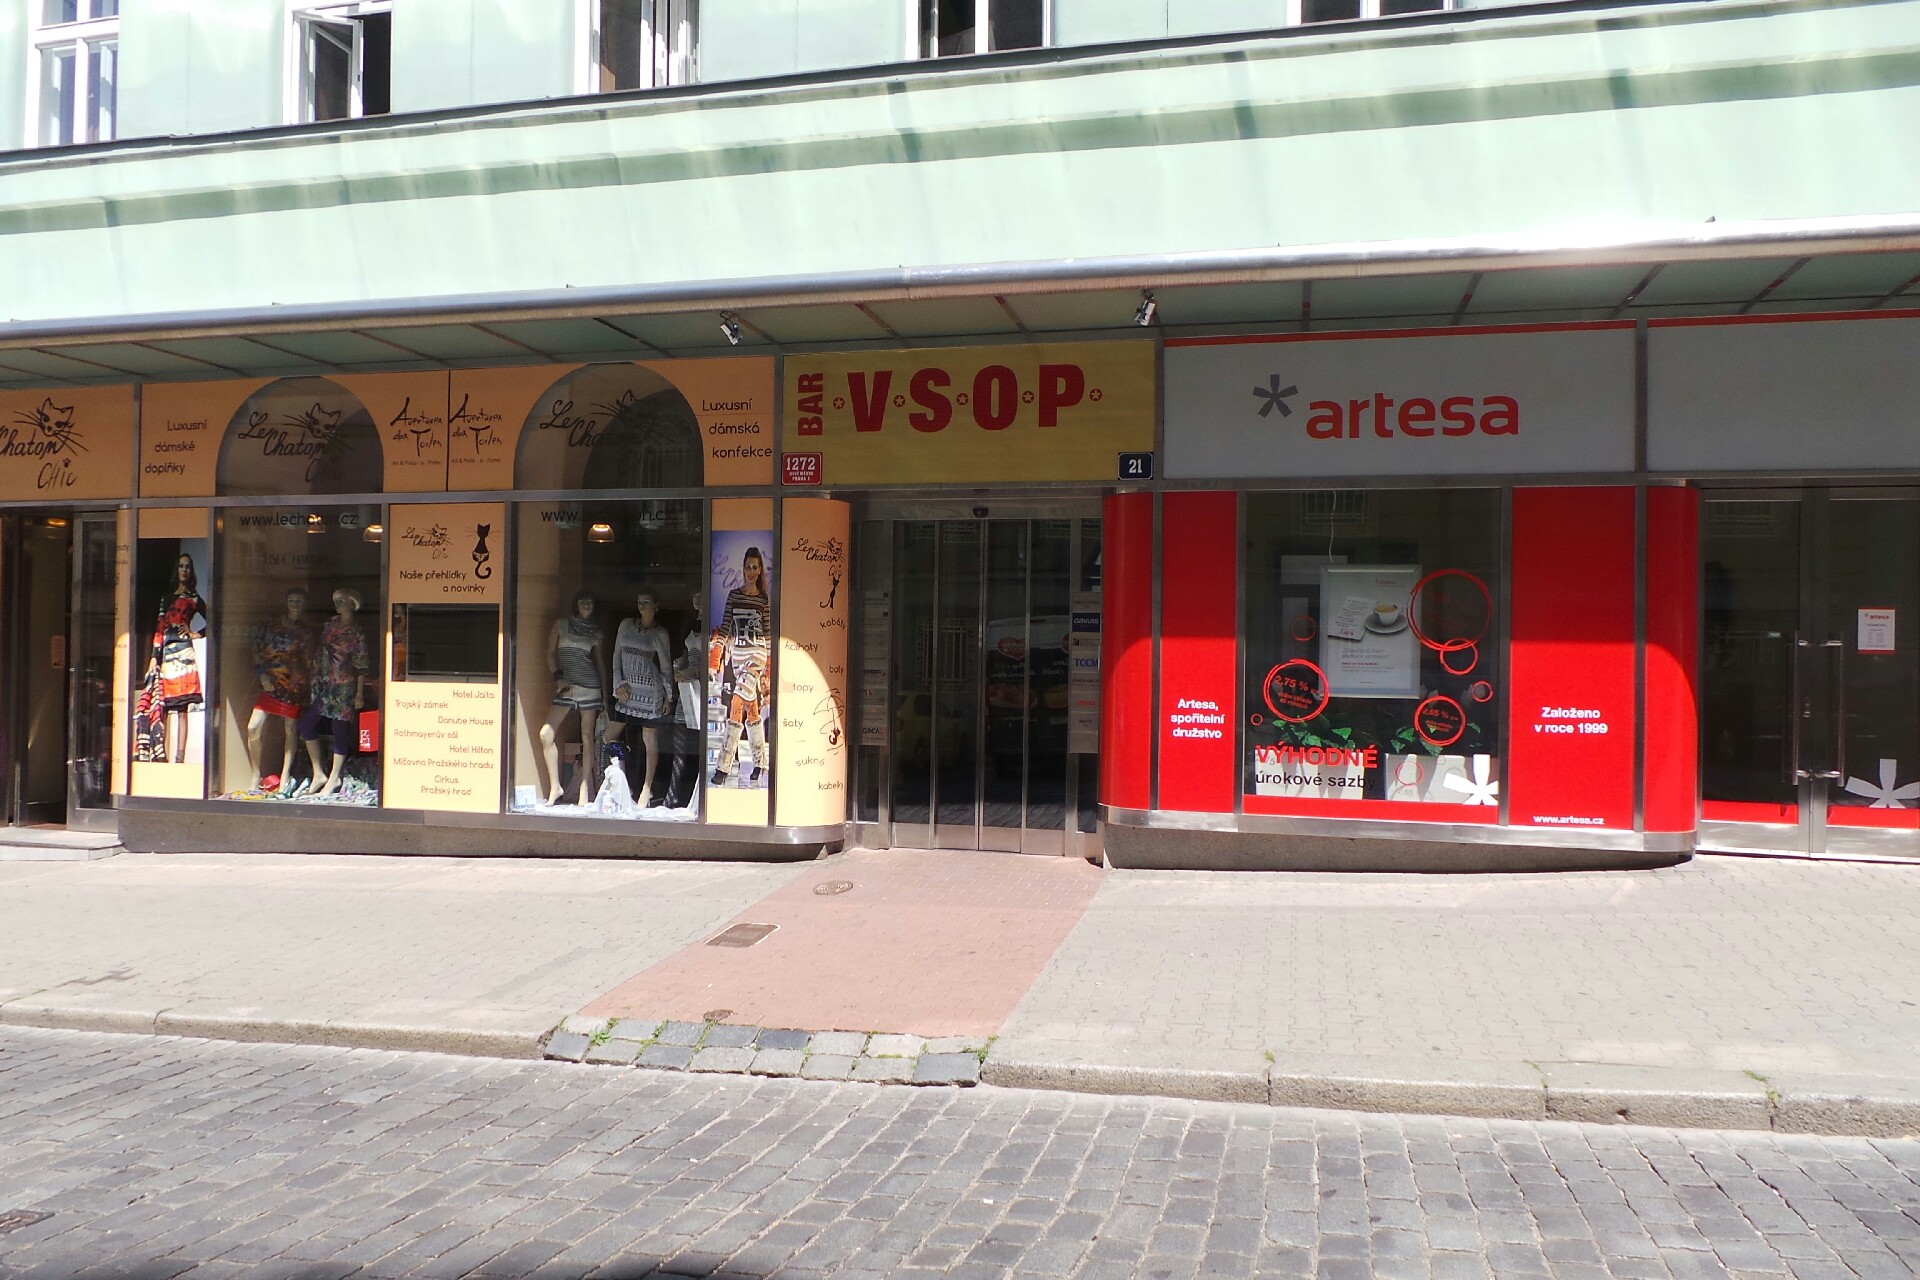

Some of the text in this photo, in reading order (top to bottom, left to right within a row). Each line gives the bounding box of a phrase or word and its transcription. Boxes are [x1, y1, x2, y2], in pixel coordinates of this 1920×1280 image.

[702, 398, 753, 412] Luxusní
[797, 373, 823, 436] BAR
[1305, 392, 1519, 439] artesa
[166, 418, 208, 432] Luxusní
[708, 421, 760, 435] dámská
[154, 440, 196, 453] dámské
[711, 445, 773, 459] konfekce
[144, 463, 186, 476] doplňky
[786, 457, 816, 471] 1272
[1128, 458, 1143, 474] 21
[399, 570, 467, 581] Naše přehlídky
[450, 583, 486, 594] novinky
[792, 682, 814, 693] topy
[1298, 680, 1309, 691] %
[452, 689, 473, 699] Hotel
[395, 699, 449, 709] Trojský zámek
[1177, 698, 1219, 711] Artesa,
[1170, 712, 1226, 725] spořitelní
[1541, 706, 1601, 719] Založeno
[438, 715, 494, 726] Danube House
[782, 718, 803, 730] šaty
[1172, 727, 1223, 739] družstvo
[1534, 722, 1608, 734] v roce 1999
[447, 730, 459, 739] sál
[449, 745, 494, 754] Hotel Hilton
[1255, 743, 1379, 769] VÝHODNÉ
[428, 758, 468, 768] Pražského
[469, 760, 494, 769] hradu
[434, 774, 459, 784] Cirkus
[1255, 770, 1377, 791] úrokové sazby
[420, 785, 472, 797] Pražský hrad
[1533, 813, 1605, 825] www.artesa.cz
